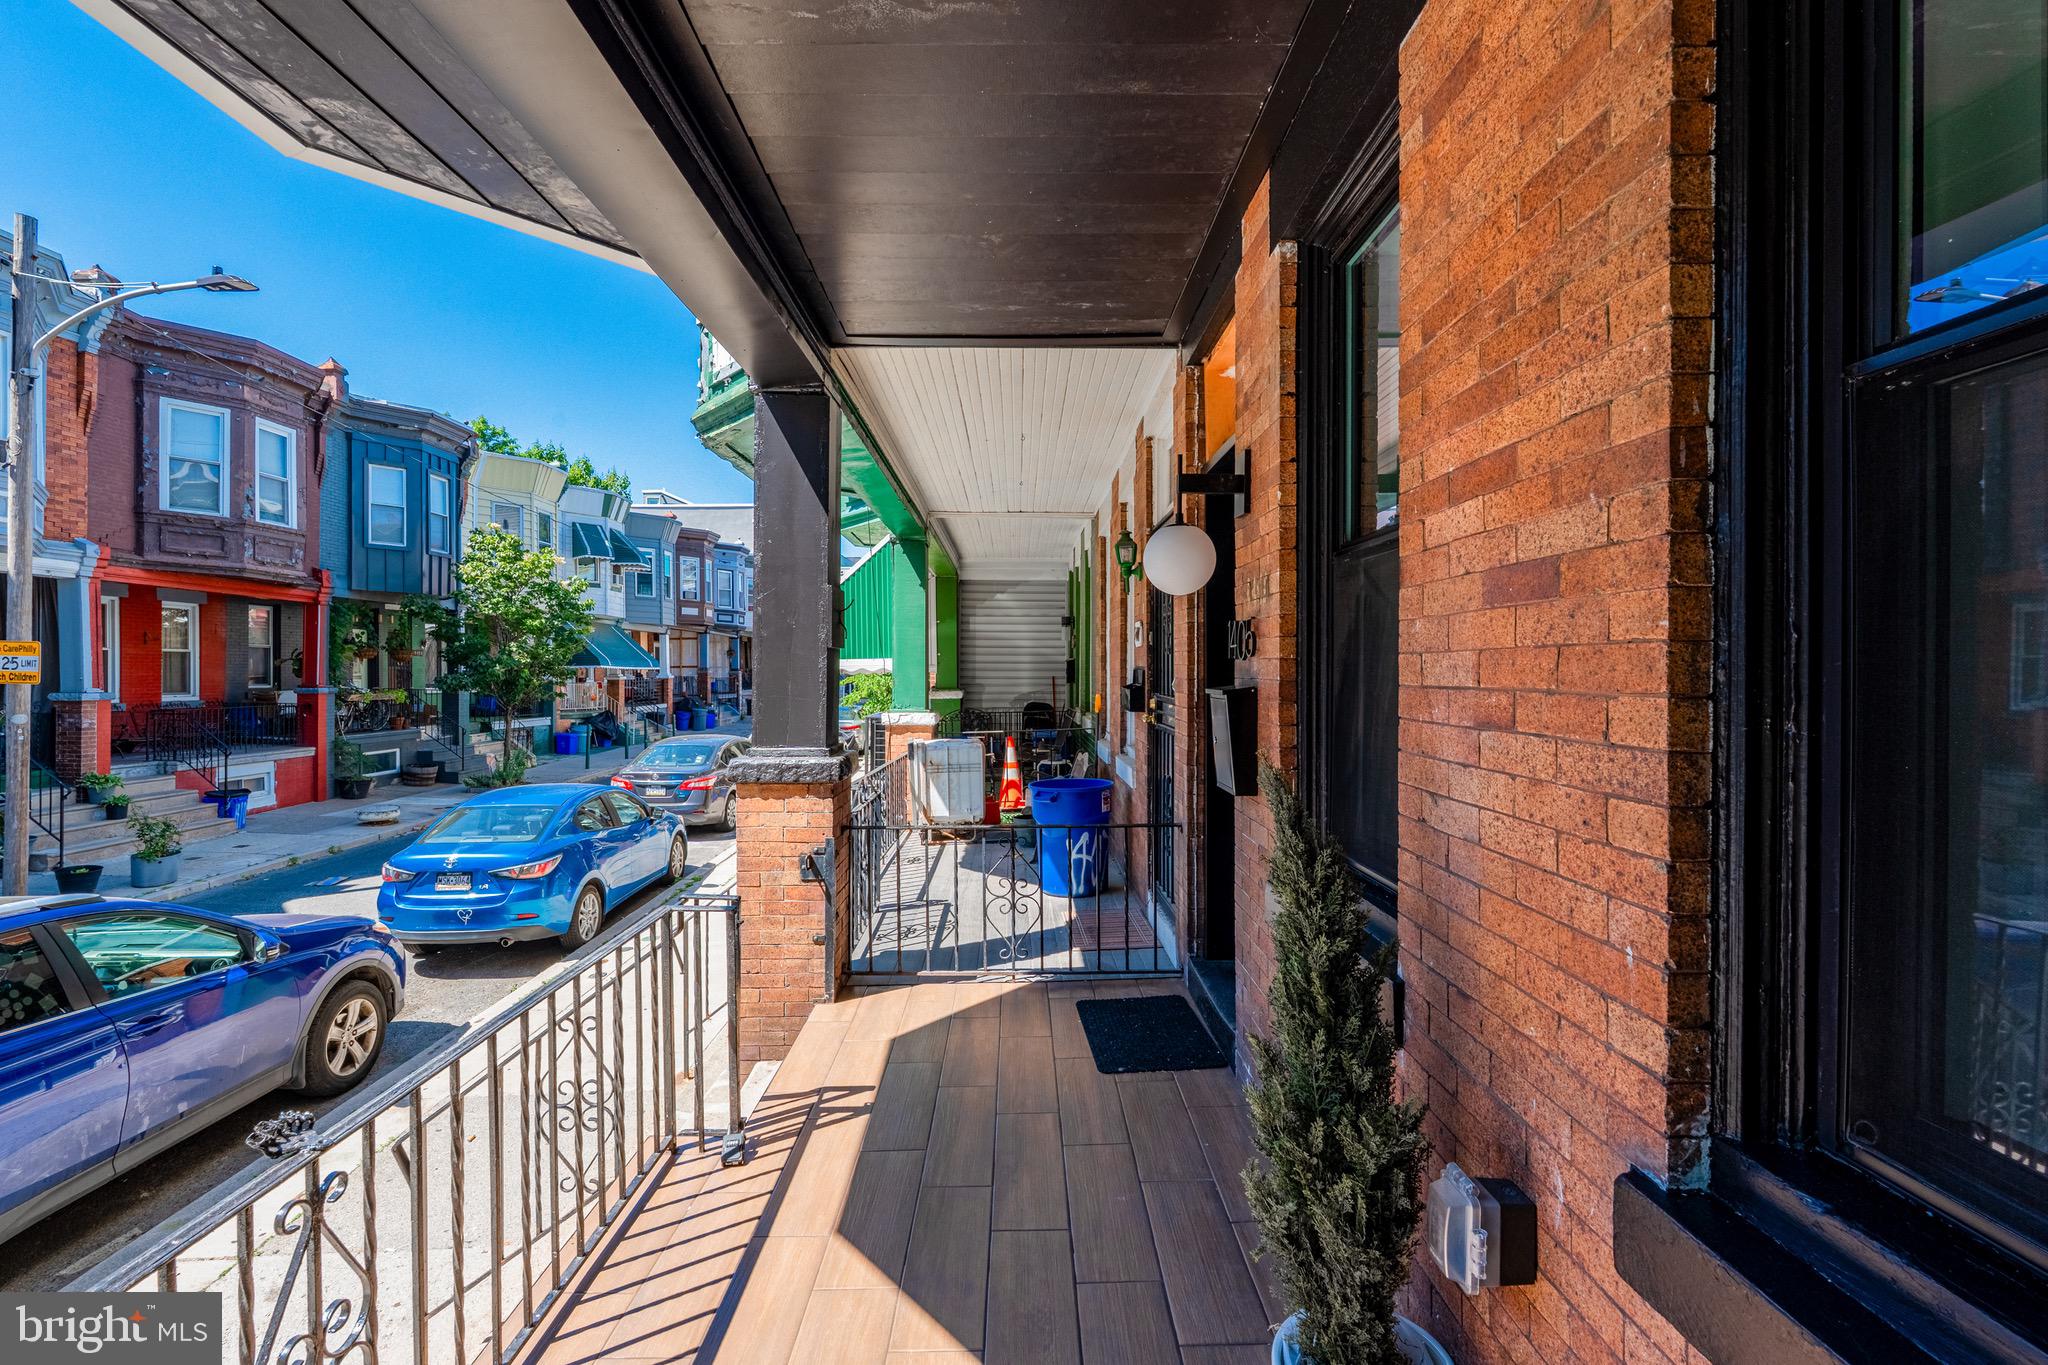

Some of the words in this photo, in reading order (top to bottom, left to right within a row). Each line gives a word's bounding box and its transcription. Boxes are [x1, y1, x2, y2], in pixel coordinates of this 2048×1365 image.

[3, 644, 37, 654] CarePhilly
[2, 656, 19, 670] 25
[21, 659, 37, 668] LIMIT
[9, 672, 37, 681] Children
